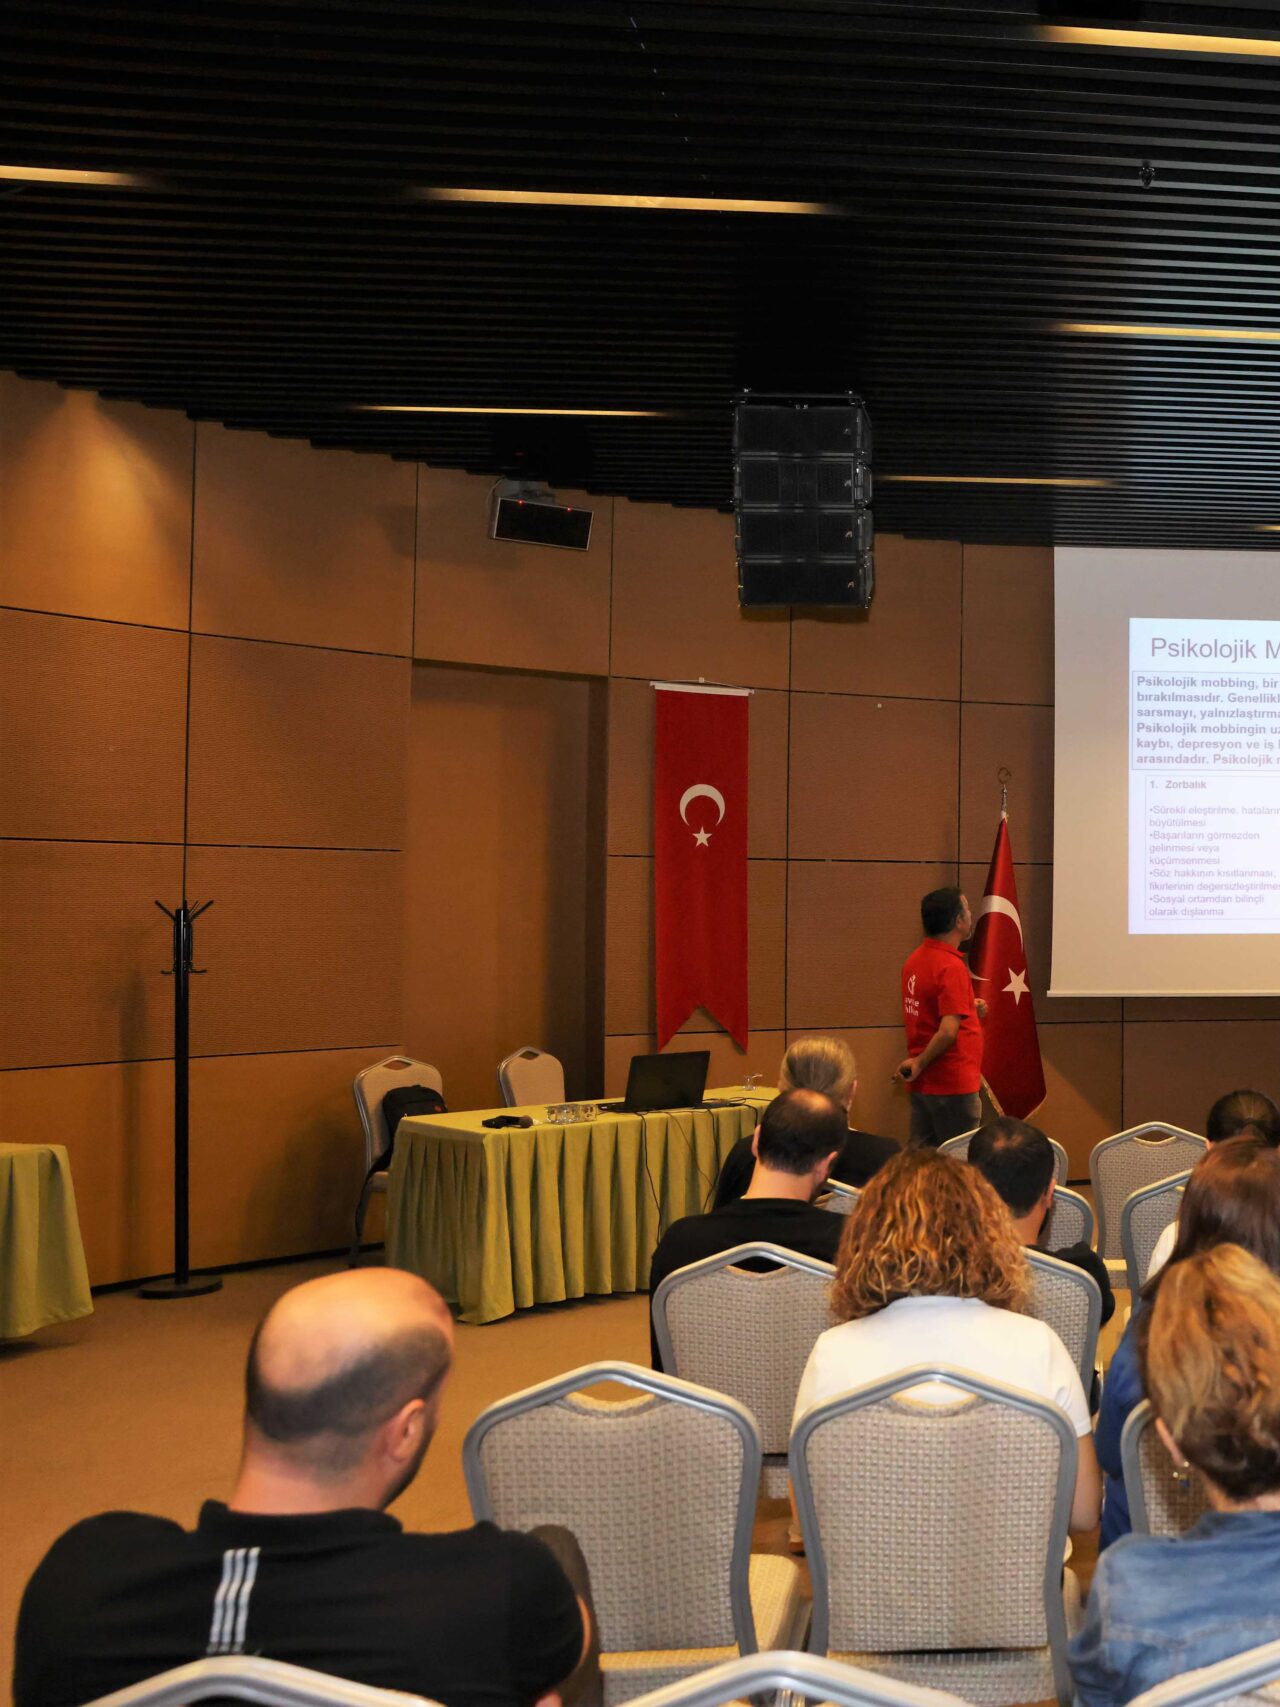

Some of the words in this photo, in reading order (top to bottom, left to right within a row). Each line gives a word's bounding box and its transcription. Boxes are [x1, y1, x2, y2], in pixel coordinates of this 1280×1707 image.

[1151, 638, 1256, 663] Psikolojik
[1137, 676, 1197, 688] Psikolojik
[1201, 679, 1259, 690] mobbing,
[1263, 679, 1278, 689] bir
[1137, 692, 1223, 703] bırakılmasıdır.
[1137, 708, 1196, 720] sarsmayı,
[1137, 723, 1197, 735] Psikolojik
[1201, 725, 1266, 736] mobbingin
[1137, 739, 1173, 751] kaybı,
[1177, 739, 1242, 751] depresyon
[1246, 741, 1260, 749] ve
[1264, 741, 1274, 752] iş
[1137, 755, 1209, 764] arasındadır.
[1213, 755, 1272, 767] Psikolojik
[1165, 781, 1206, 789] Zorbalık
[1153, 895, 1185, 905] Sosyal
